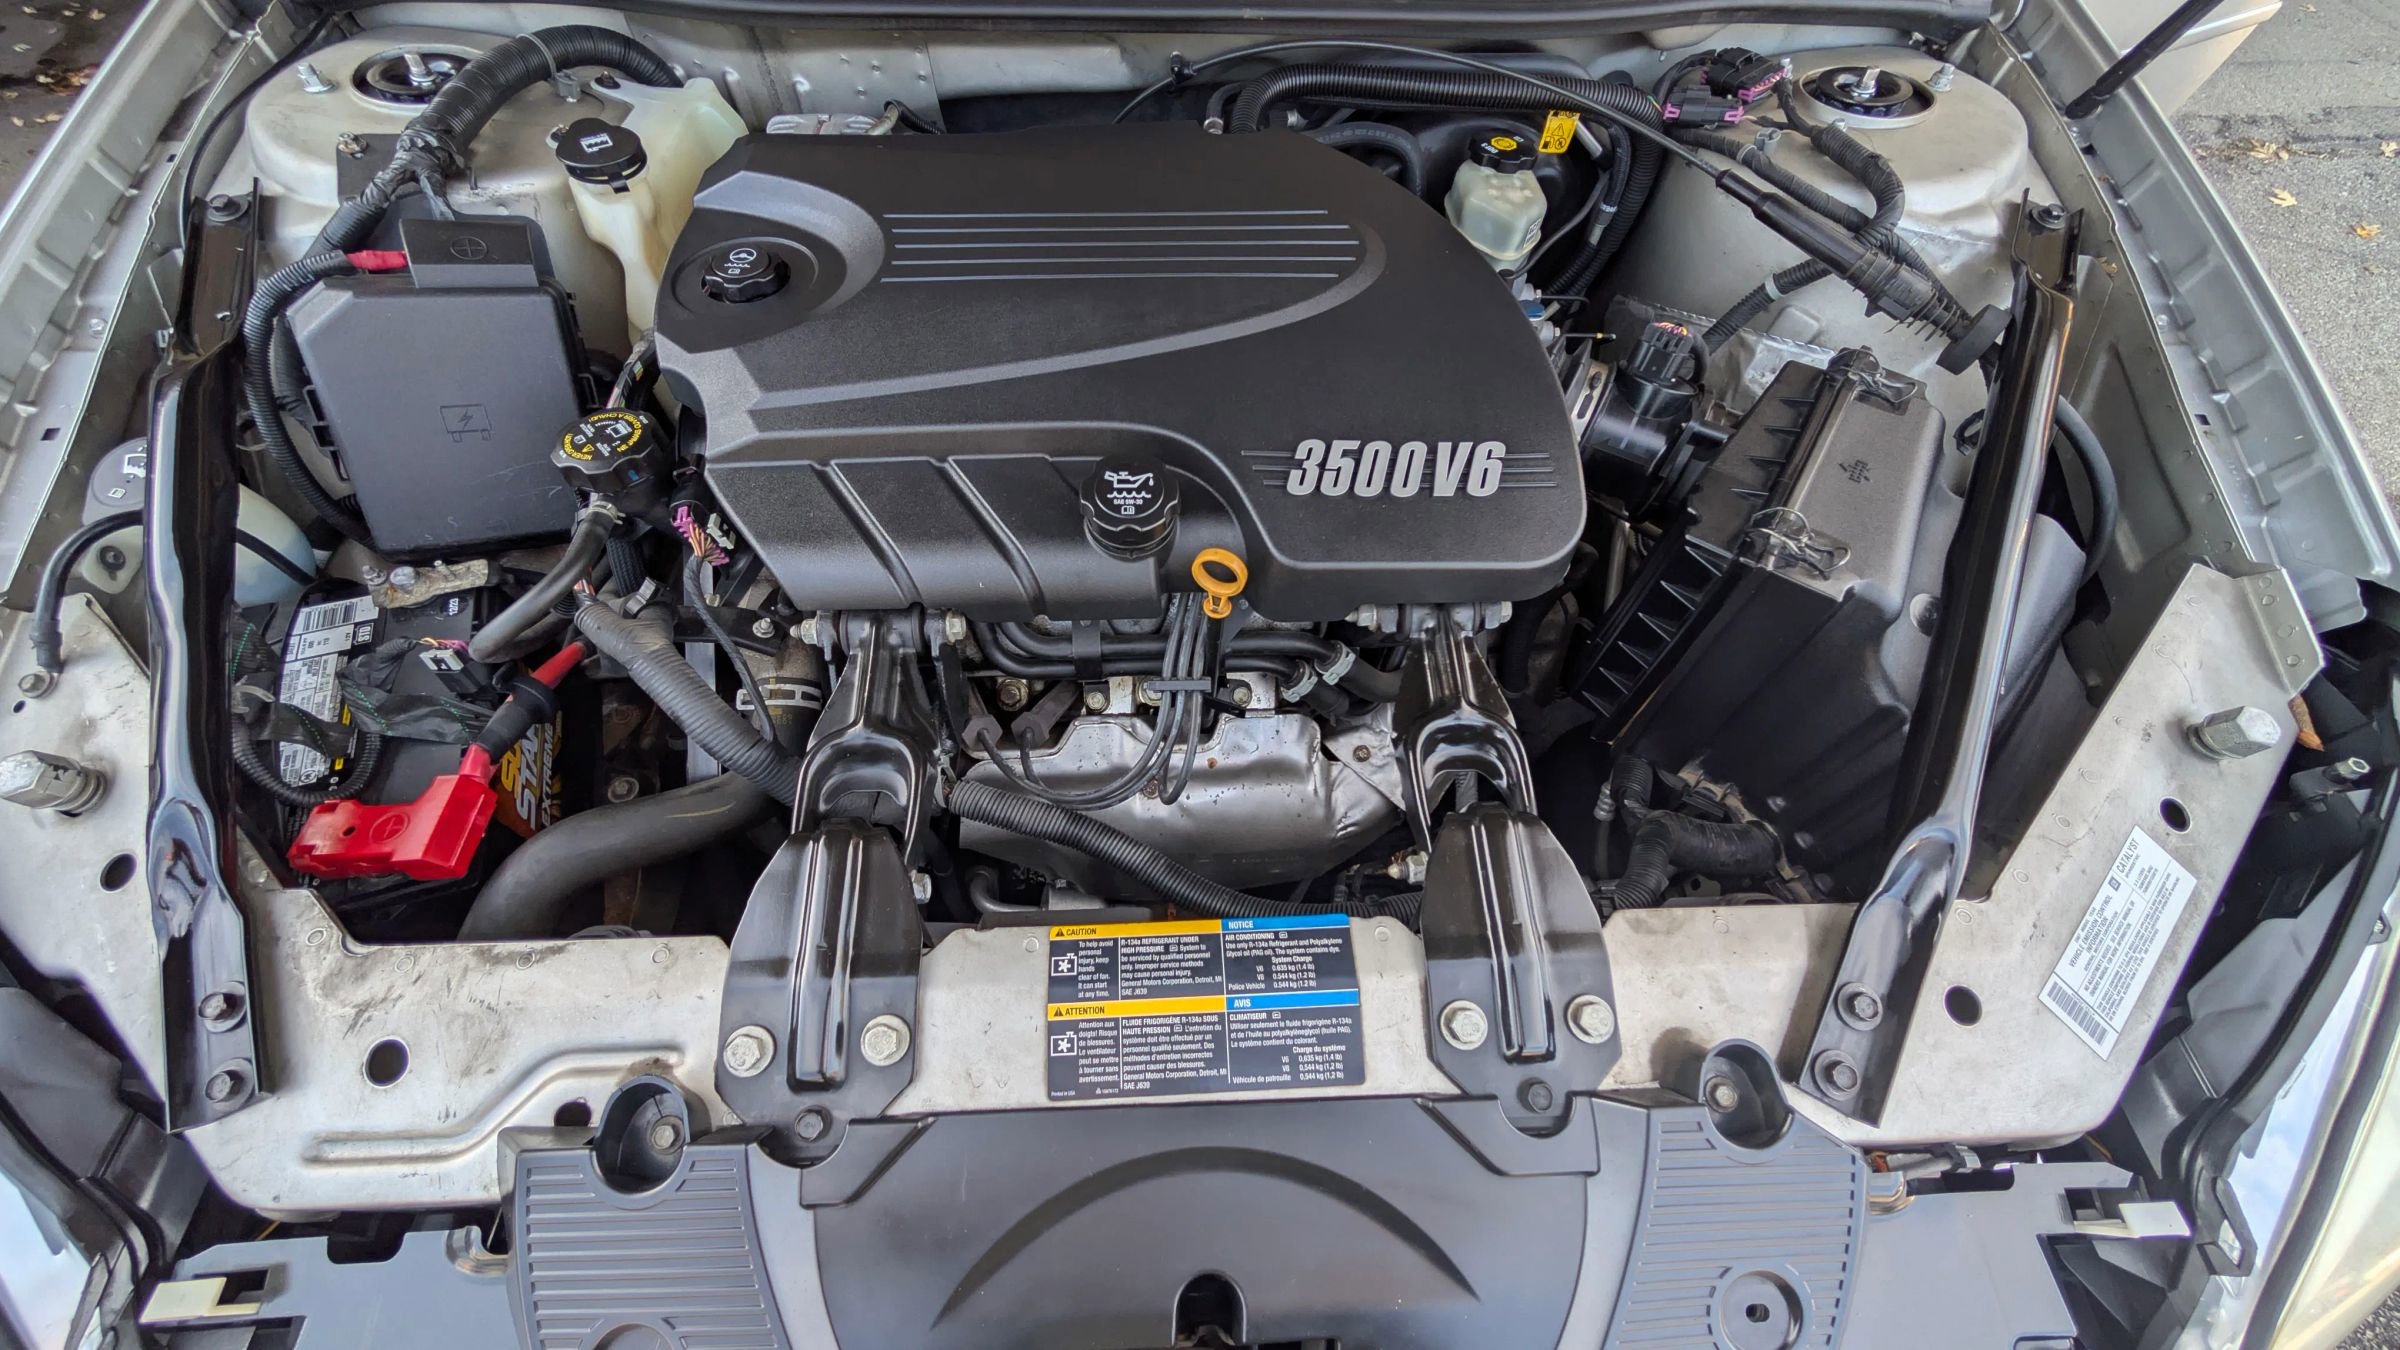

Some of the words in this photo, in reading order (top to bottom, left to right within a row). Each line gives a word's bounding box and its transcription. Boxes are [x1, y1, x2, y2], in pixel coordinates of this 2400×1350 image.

[1286, 439, 1428, 498] 3500
[1433, 441, 1507, 497] V6
[2115, 837, 2140, 874] CATALYST
[1228, 920, 1253, 929] NOTICE
[1066, 927, 1096, 935] CAUTION
[2067, 942, 2085, 968] VEHICLE
[2080, 916, 2100, 946] EMISSION
[2095, 893, 2112, 919] CONTROL
[1233, 999, 1251, 1007] AVIS
[1064, 1006, 1104, 1015] ATTENTION
